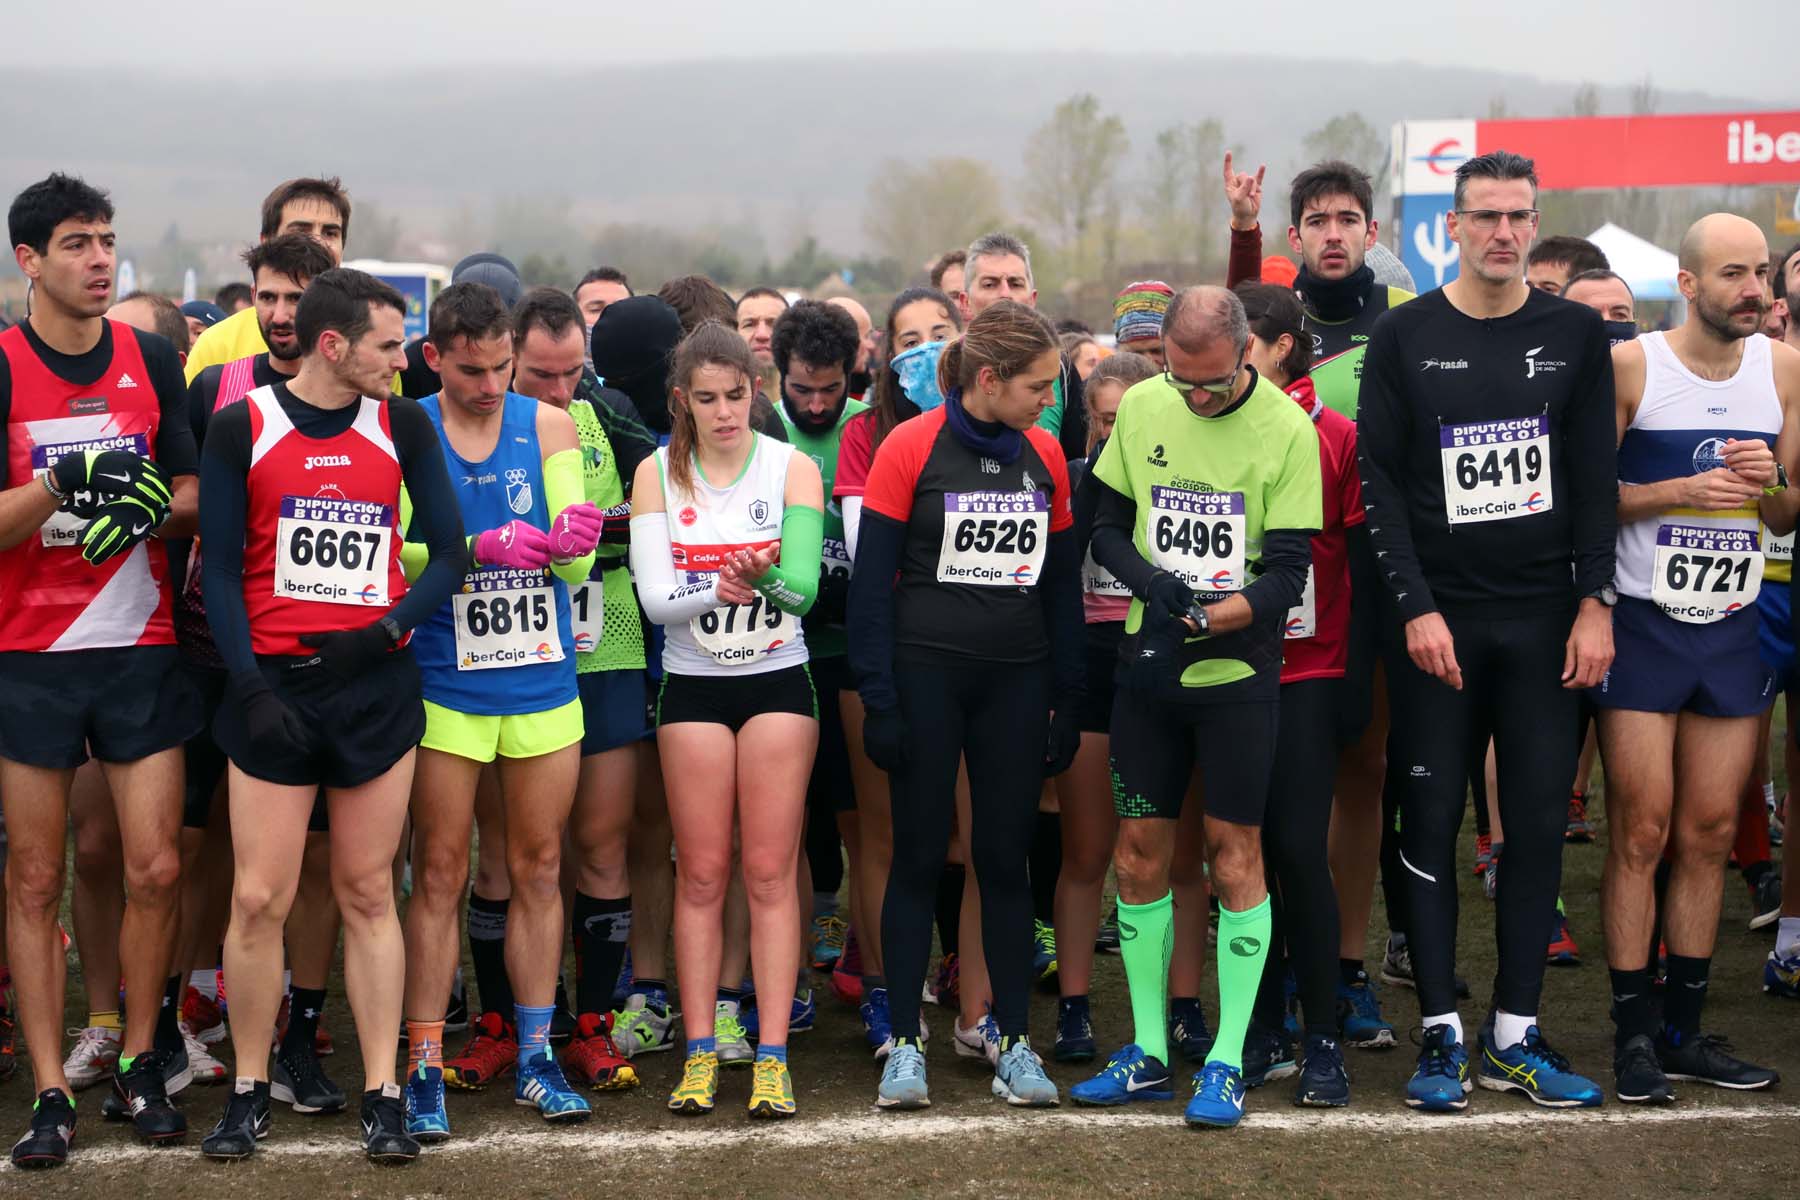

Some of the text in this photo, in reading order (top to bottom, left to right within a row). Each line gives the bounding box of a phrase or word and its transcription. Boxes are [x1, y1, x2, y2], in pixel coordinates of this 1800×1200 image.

[1441, 359, 1468, 369] rasán
[1453, 418, 1539, 436] DIPUTACIÓN
[1454, 428, 1540, 446] BURGOS
[1456, 445, 1541, 490] 6419
[957, 492, 1033, 502] DIPUTACIÓN
[1160, 488, 1231, 504] DIPUTACIÓN
[295, 498, 384, 515] DIPUTACIÓN
[958, 502, 1036, 512] BURGOS
[1158, 498, 1232, 514] BURGOS
[1456, 501, 1516, 516] iberCaja
[294, 508, 381, 525] BURGOS
[955, 519, 1037, 554] 6526
[1156, 515, 1233, 558] 6496
[1672, 528, 1750, 540] DIPUTACIÓN
[290, 526, 381, 571] 6667
[1671, 538, 1752, 550] BURGOS
[693, 554, 720, 562] Cafés
[945, 565, 1002, 580] iberCaja
[1667, 554, 1751, 592] 6721
[284, 579, 347, 598] iberCaja
[467, 594, 549, 637] 6815
[700, 596, 782, 634] 6775
